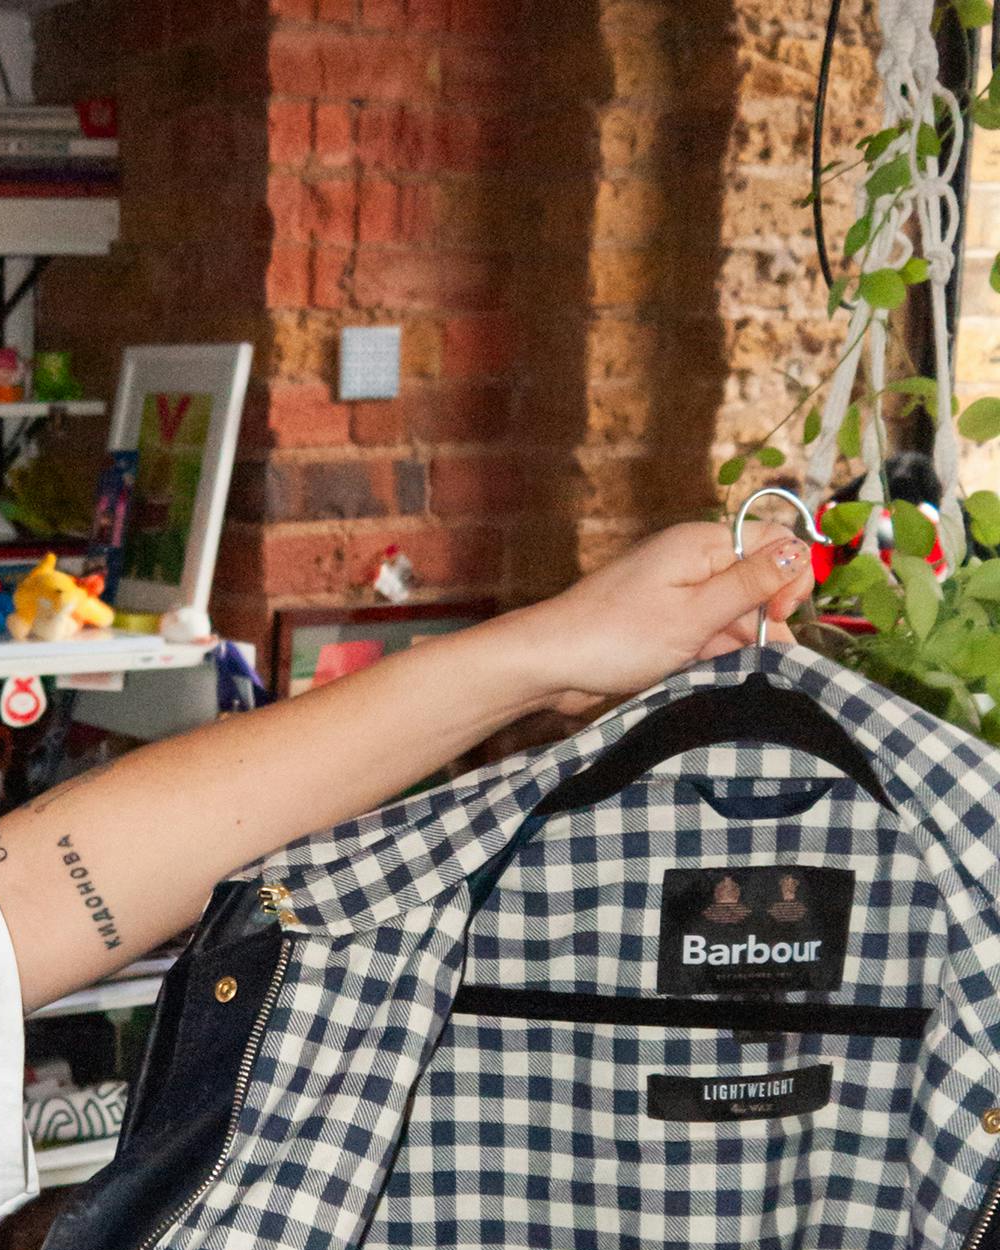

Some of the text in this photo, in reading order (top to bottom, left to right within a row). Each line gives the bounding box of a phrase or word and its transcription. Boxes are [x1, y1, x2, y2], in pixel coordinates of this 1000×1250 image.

[57, 834, 124, 951] КИДОНОВА
[682, 934, 822, 966] Barbour
[703, 1077, 795, 1101] LIGHTWEIGHT
